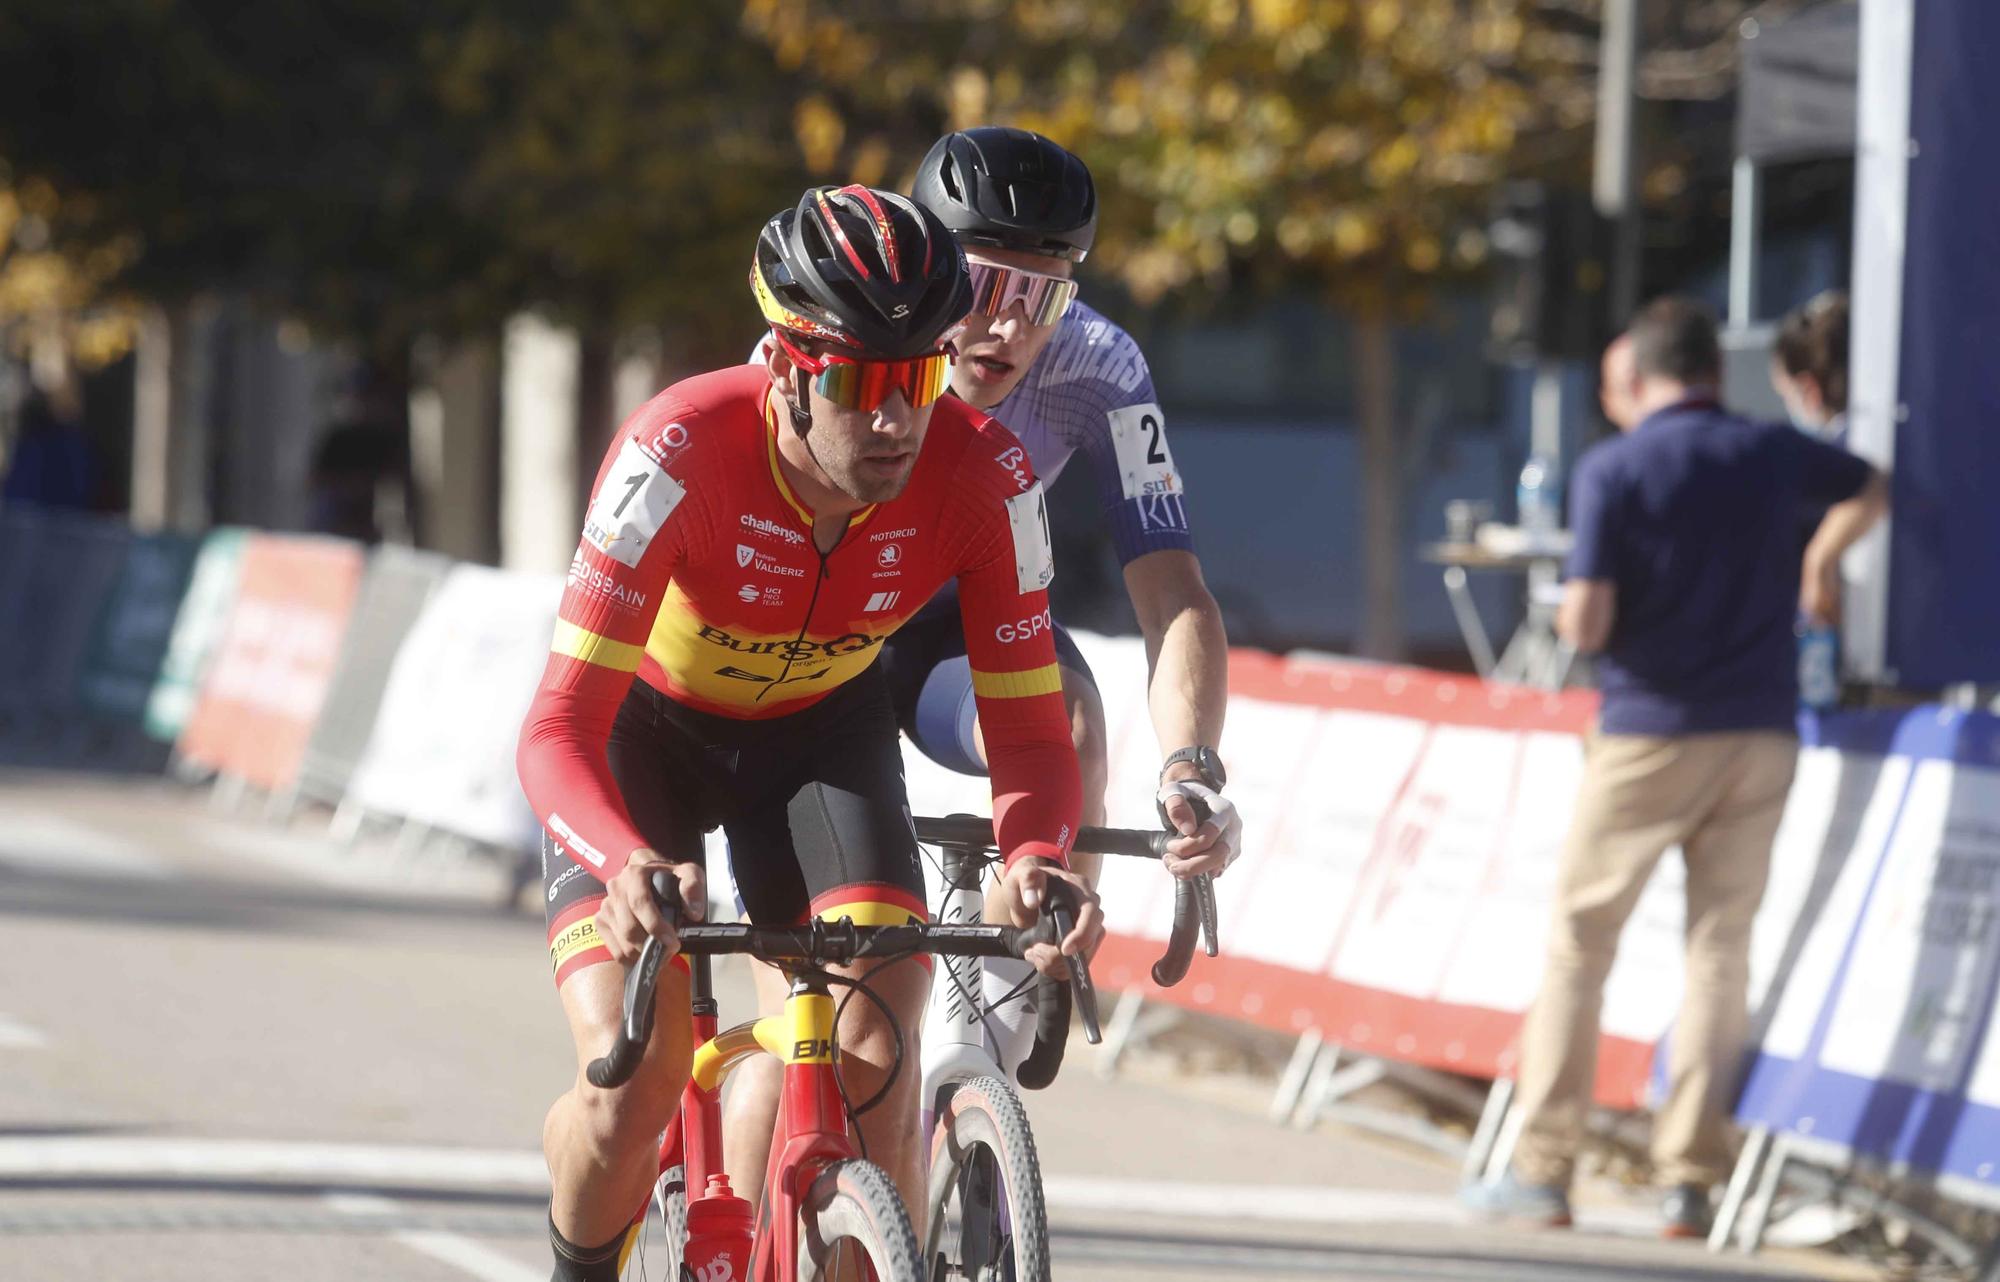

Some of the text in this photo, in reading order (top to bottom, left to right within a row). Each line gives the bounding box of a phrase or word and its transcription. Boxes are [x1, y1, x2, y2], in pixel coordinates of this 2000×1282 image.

[1140, 415, 1166, 464] 2
[613, 471, 650, 519] 1
[869, 527, 917, 543] MOTORCID
[1038, 493, 1049, 547] 1
[579, 561, 646, 607] DISBAIN
[754, 558, 805, 578] VALDERIZ
[765, 587, 782, 595] UCI
[556, 923, 599, 952] DISB
